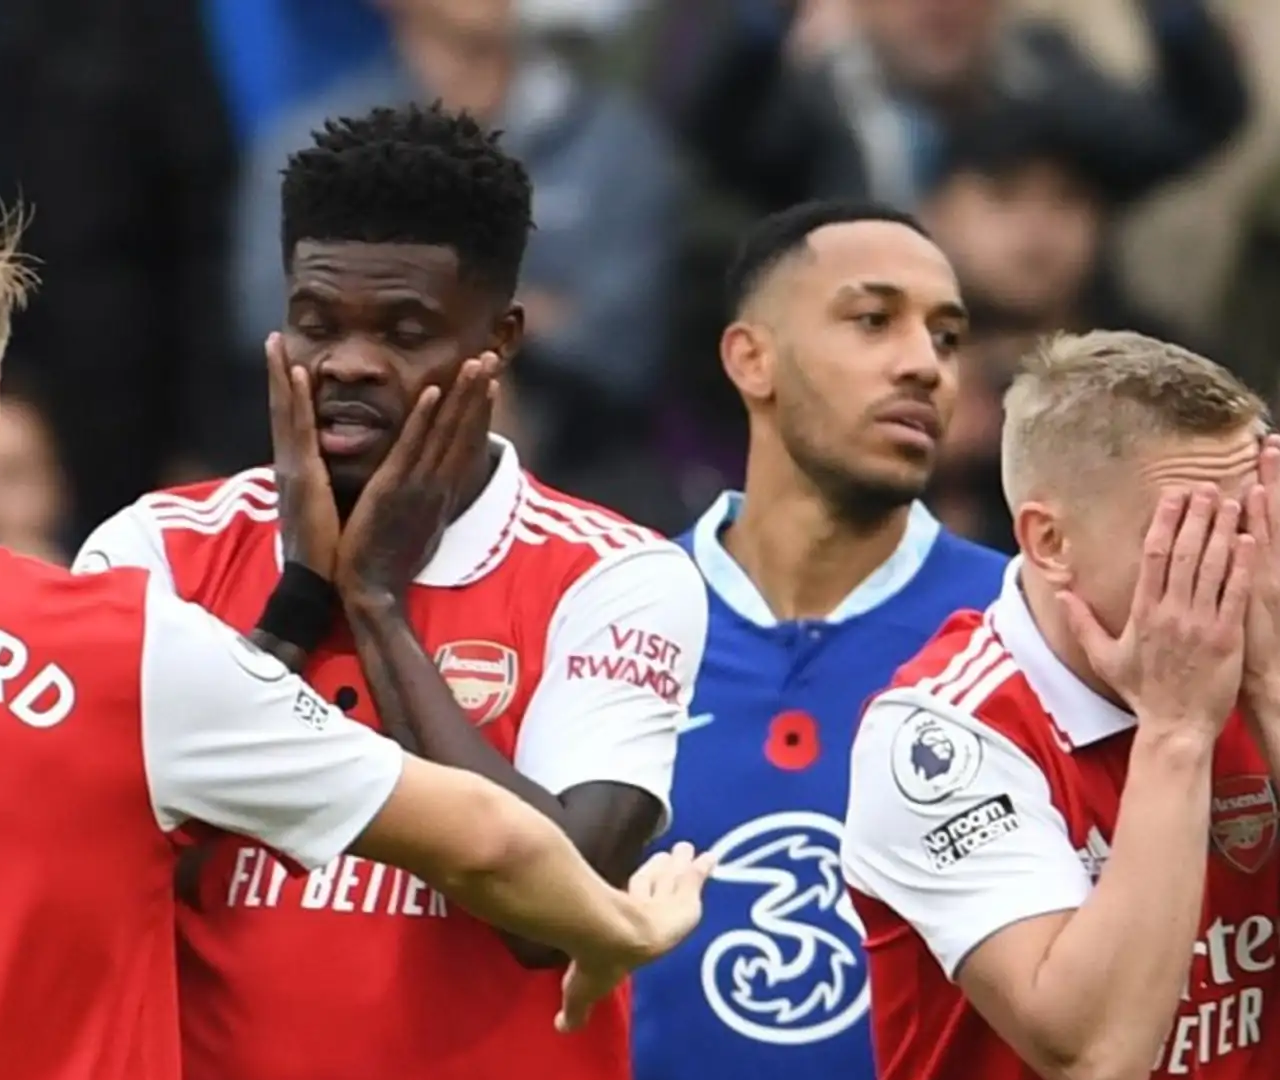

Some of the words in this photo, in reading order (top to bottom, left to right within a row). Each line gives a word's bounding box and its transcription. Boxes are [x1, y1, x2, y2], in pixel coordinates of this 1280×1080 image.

[609, 623, 681, 671] VISIT
[567, 655, 682, 706] RWAND
[948, 801, 1007, 841] room
